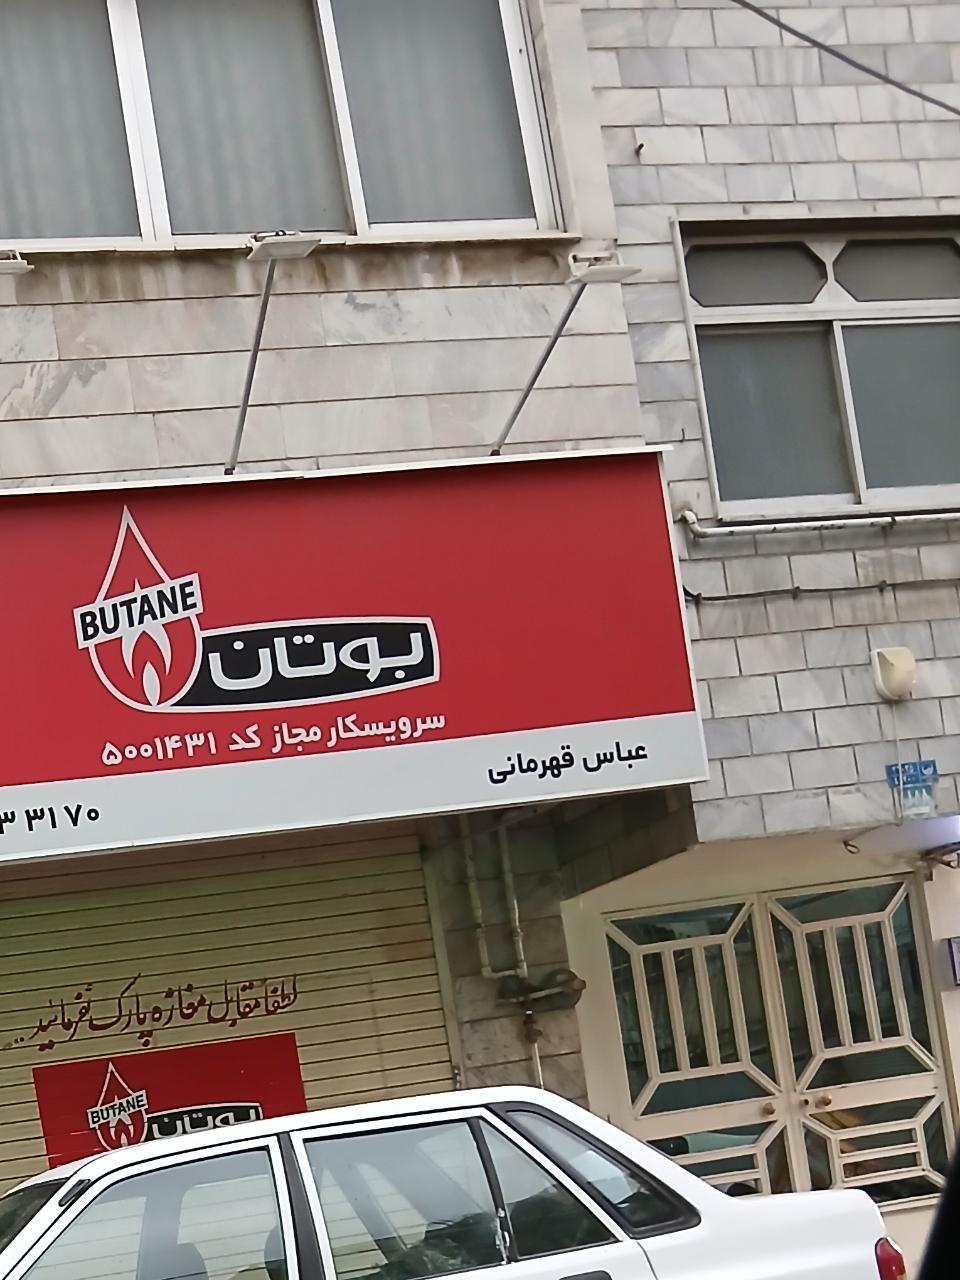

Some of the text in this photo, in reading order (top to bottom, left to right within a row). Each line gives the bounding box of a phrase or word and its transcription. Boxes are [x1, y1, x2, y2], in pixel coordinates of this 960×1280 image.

[80, 580, 198, 641] BUTANE
[208, 632, 425, 690] بوتان
[101, 713, 446, 766] سرویسکار مجاز کد ۵۰۰۱۴۳۱
[488, 741, 648, 784] عباس قهرمانی
[88, 973, 153, 1047] پارک
[151, 984, 207, 1027] مغازه
[207, 979, 261, 1028] مقابل
[90, 1094, 146, 1124] BUTANE
